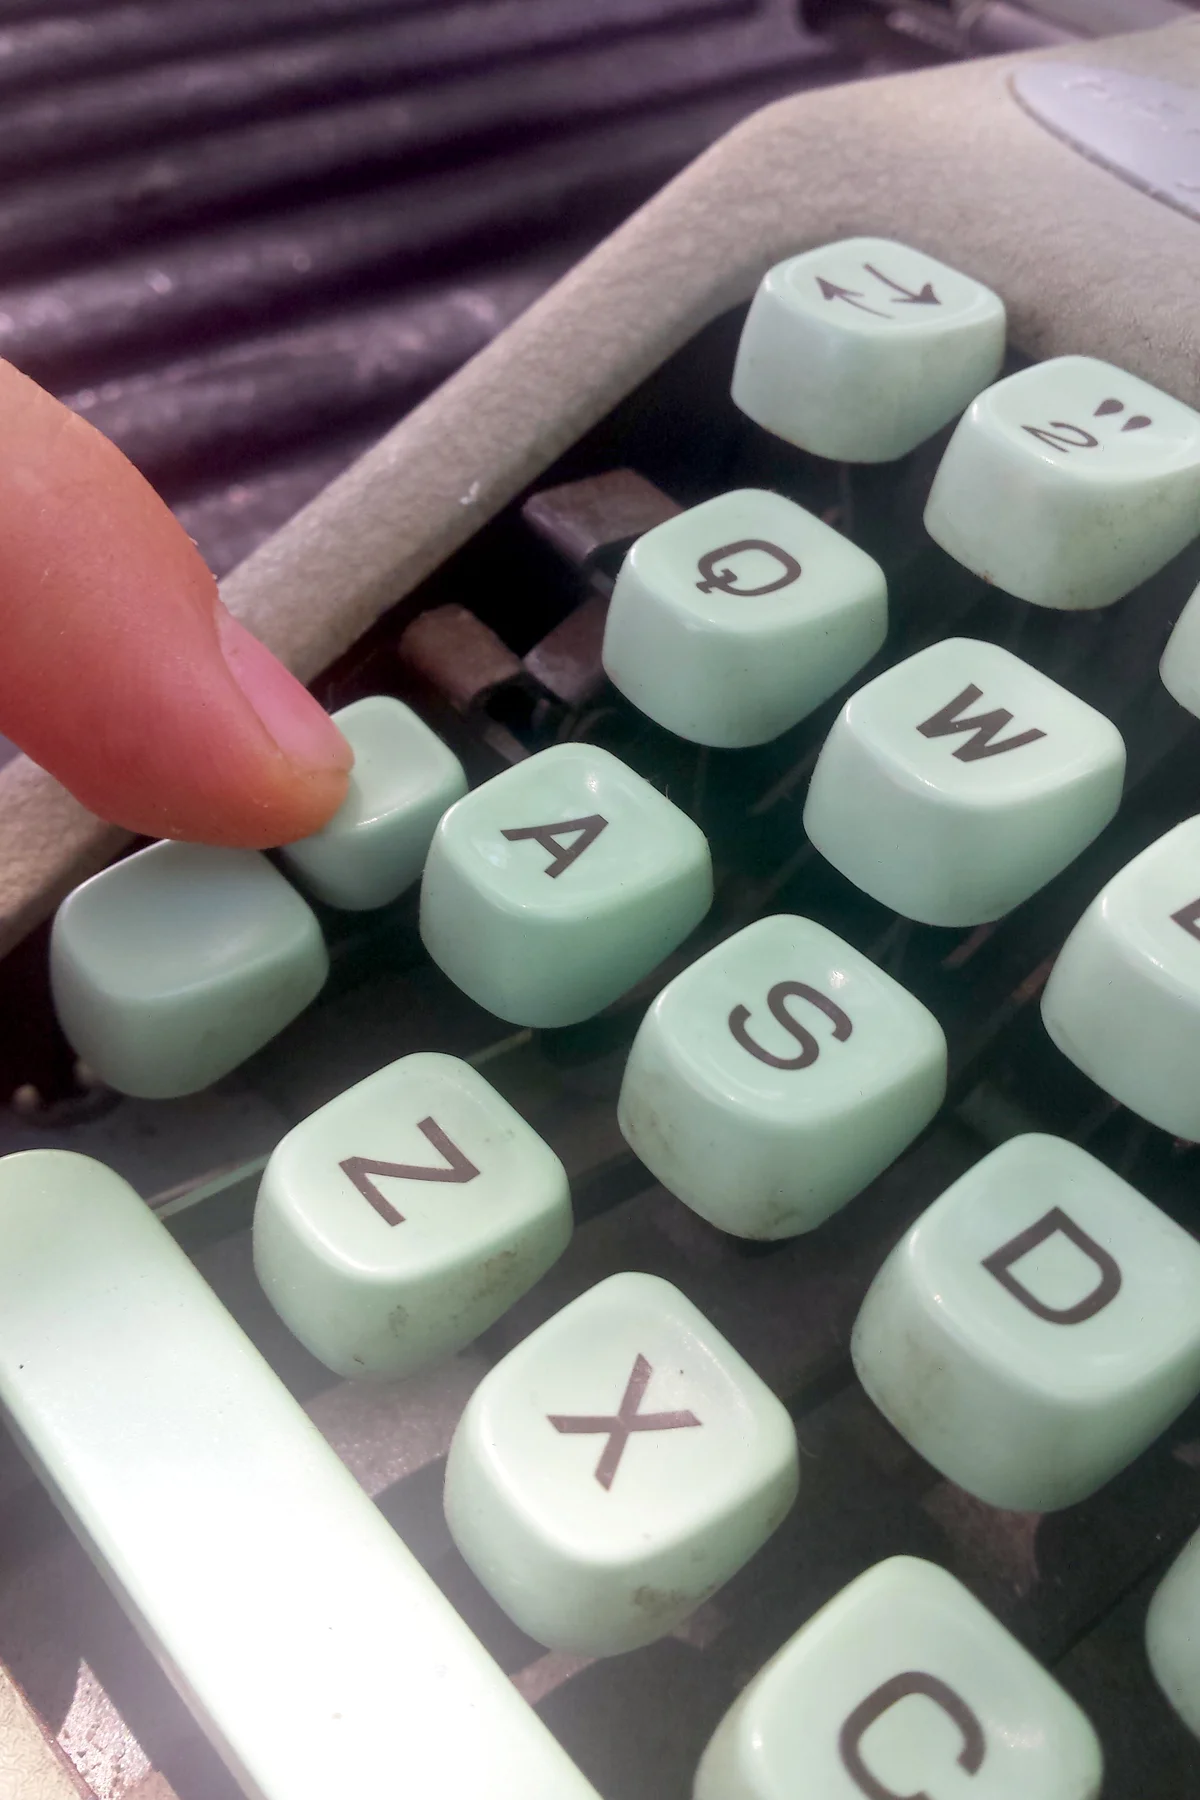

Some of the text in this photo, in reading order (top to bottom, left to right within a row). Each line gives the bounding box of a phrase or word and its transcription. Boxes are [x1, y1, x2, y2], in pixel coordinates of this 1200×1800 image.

[1021, 421, 1098, 453] 2
[696, 539, 801, 597] Q
[915, 683, 1047, 762] W
[500, 814, 609, 879] A
[728, 980, 853, 1071] S
[338, 1116, 481, 1227] Z
[980, 1206, 1122, 1326] D
[546, 1353, 703, 1491] X
[838, 1671, 985, 1800] C
